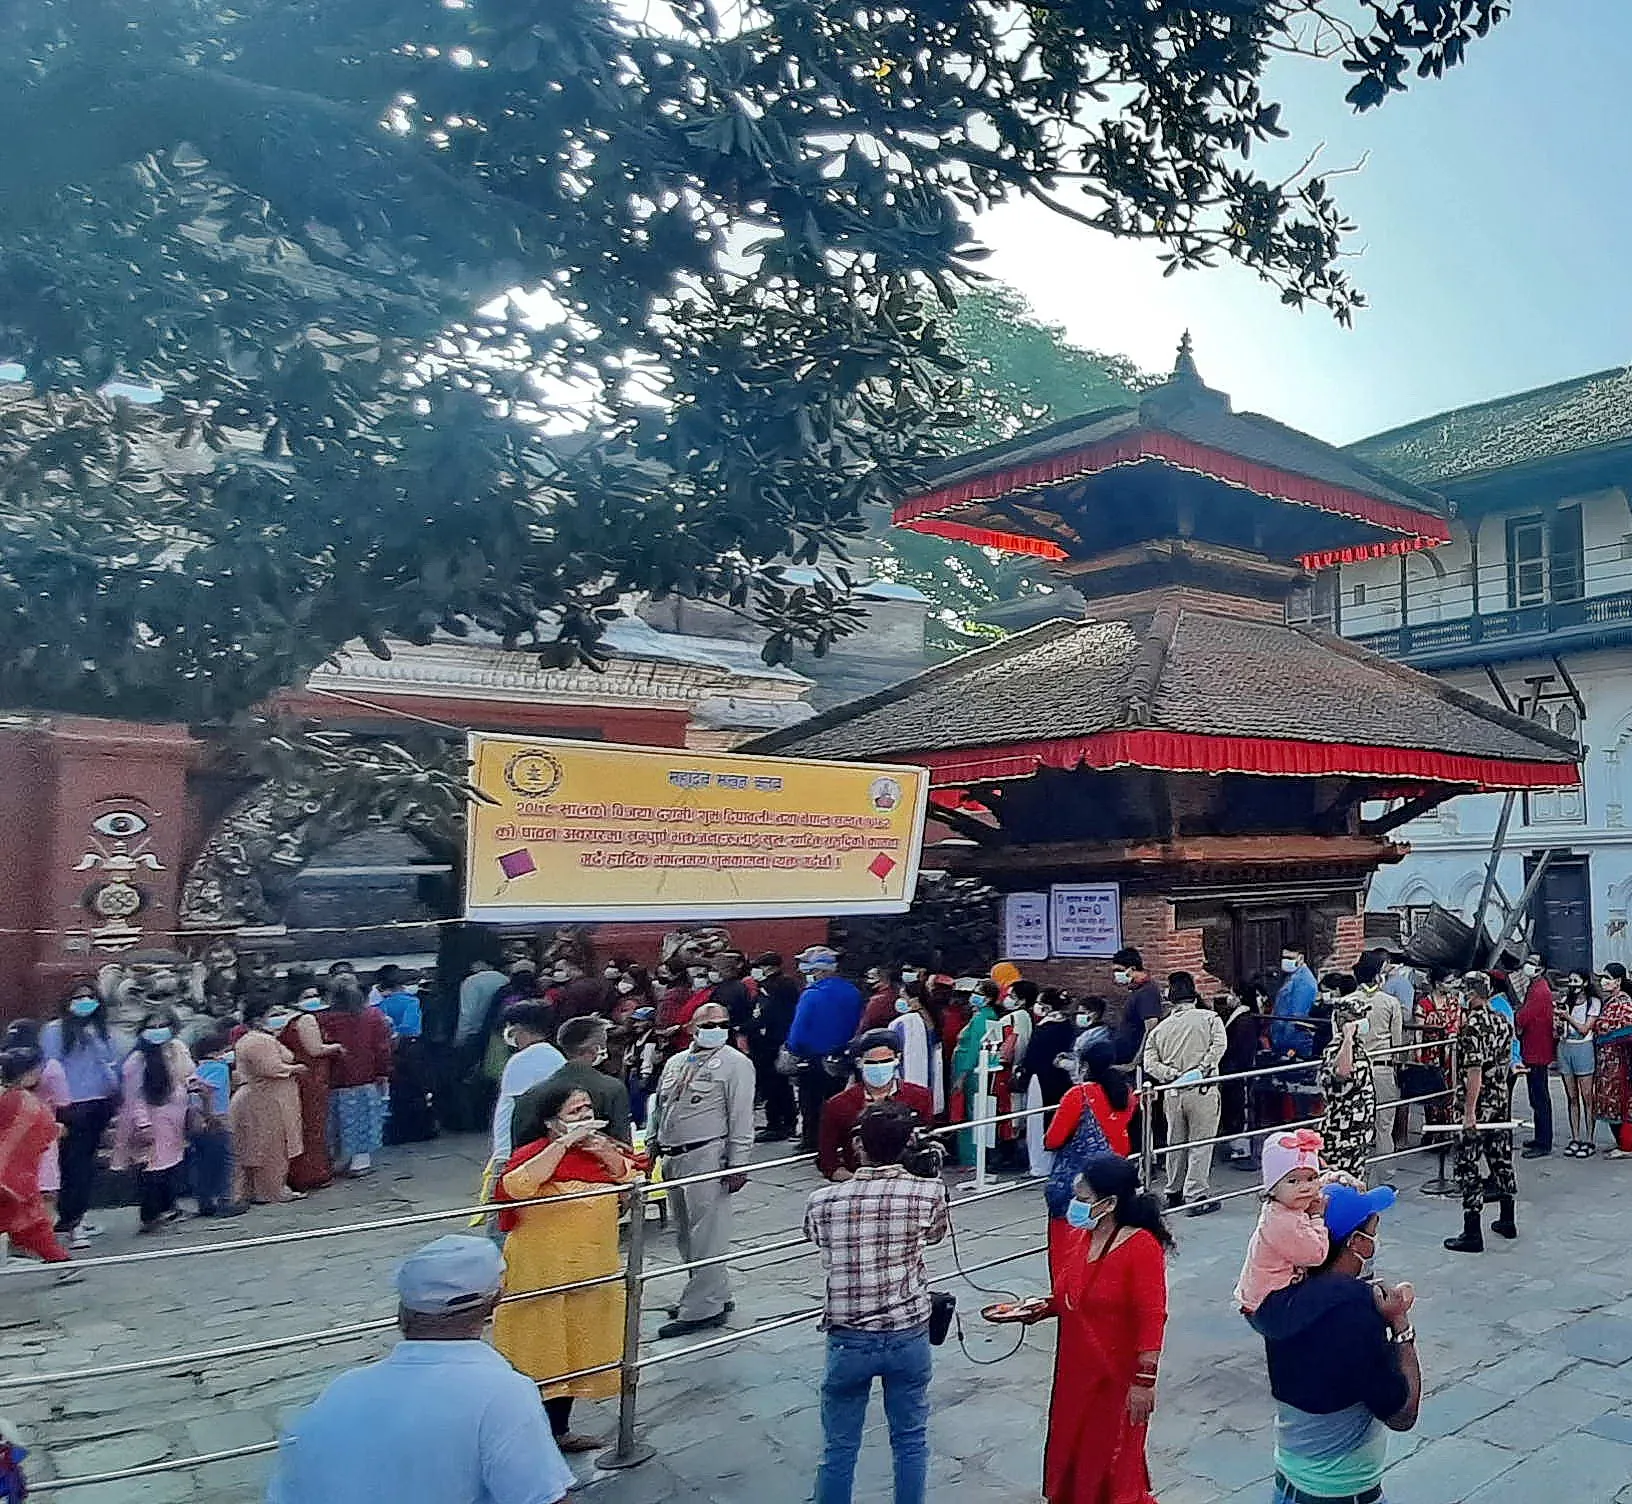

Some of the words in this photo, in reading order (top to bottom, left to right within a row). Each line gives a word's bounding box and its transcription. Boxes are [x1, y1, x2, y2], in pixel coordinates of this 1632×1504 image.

[560, 803, 606, 818] सालको
[611, 803, 651, 820] विजया
[656, 807, 692, 822] दशमी
[696, 810, 719, 826] शुभ
[775, 813, 797, 826] तथा
[800, 812, 830, 827] नेपाल
[496, 823, 515, 840] को
[522, 827, 556, 841] पावन
[563, 828, 622, 843] अवसरमा
[760, 834, 786, 850] सुख
[606, 850, 648, 868] हार्दिक
